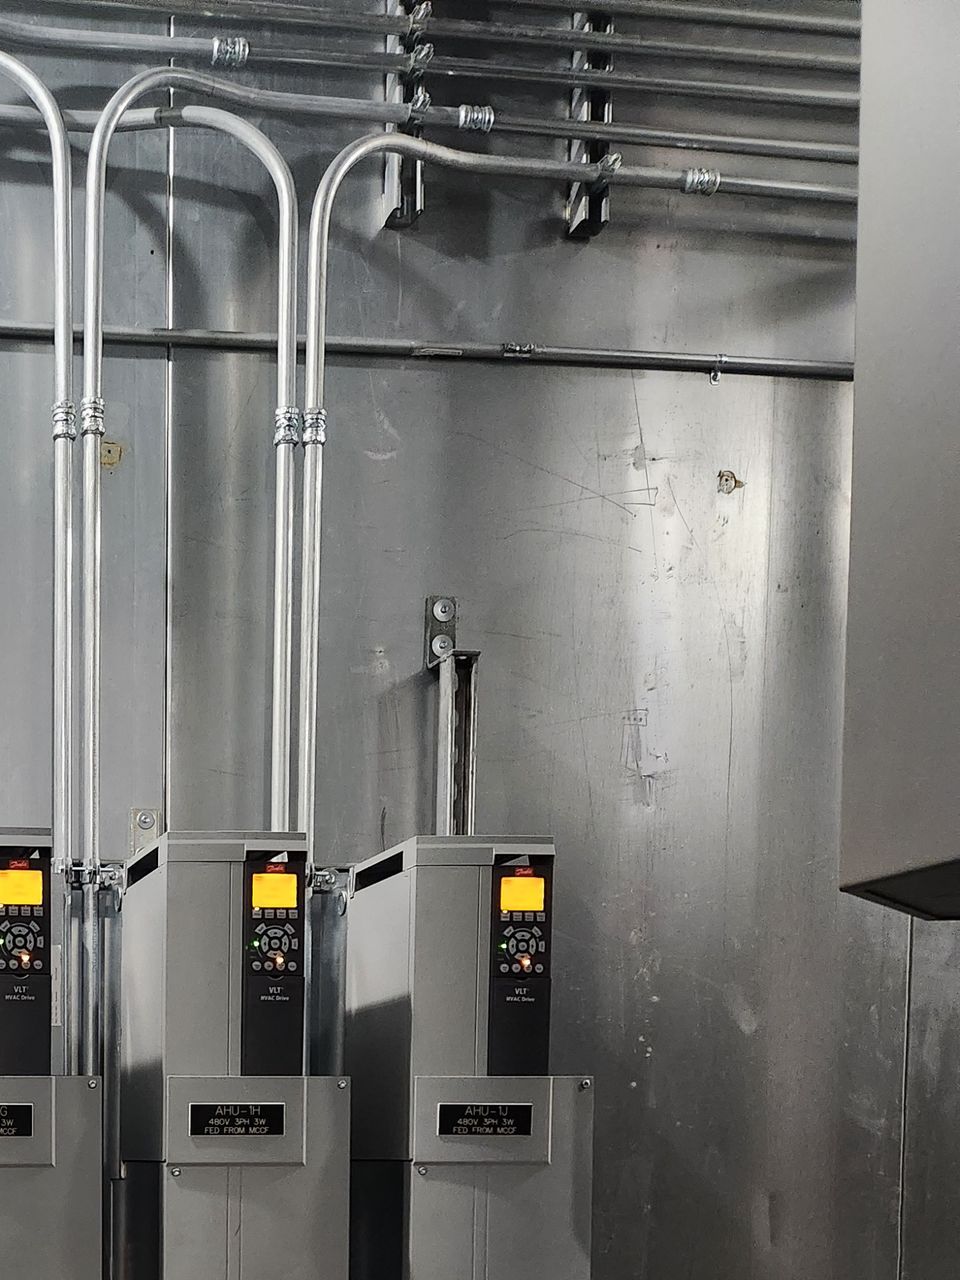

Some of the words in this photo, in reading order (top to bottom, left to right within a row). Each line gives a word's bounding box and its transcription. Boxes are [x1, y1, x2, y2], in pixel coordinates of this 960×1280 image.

[215, 1105, 261, 1116] AHU-1H
[464, 1106, 508, 1116] AHU-1J
[457, 1118, 479, 1126] 480V
[483, 1118, 498, 1126] 3PH
[452, 1126, 468, 1134] FED
